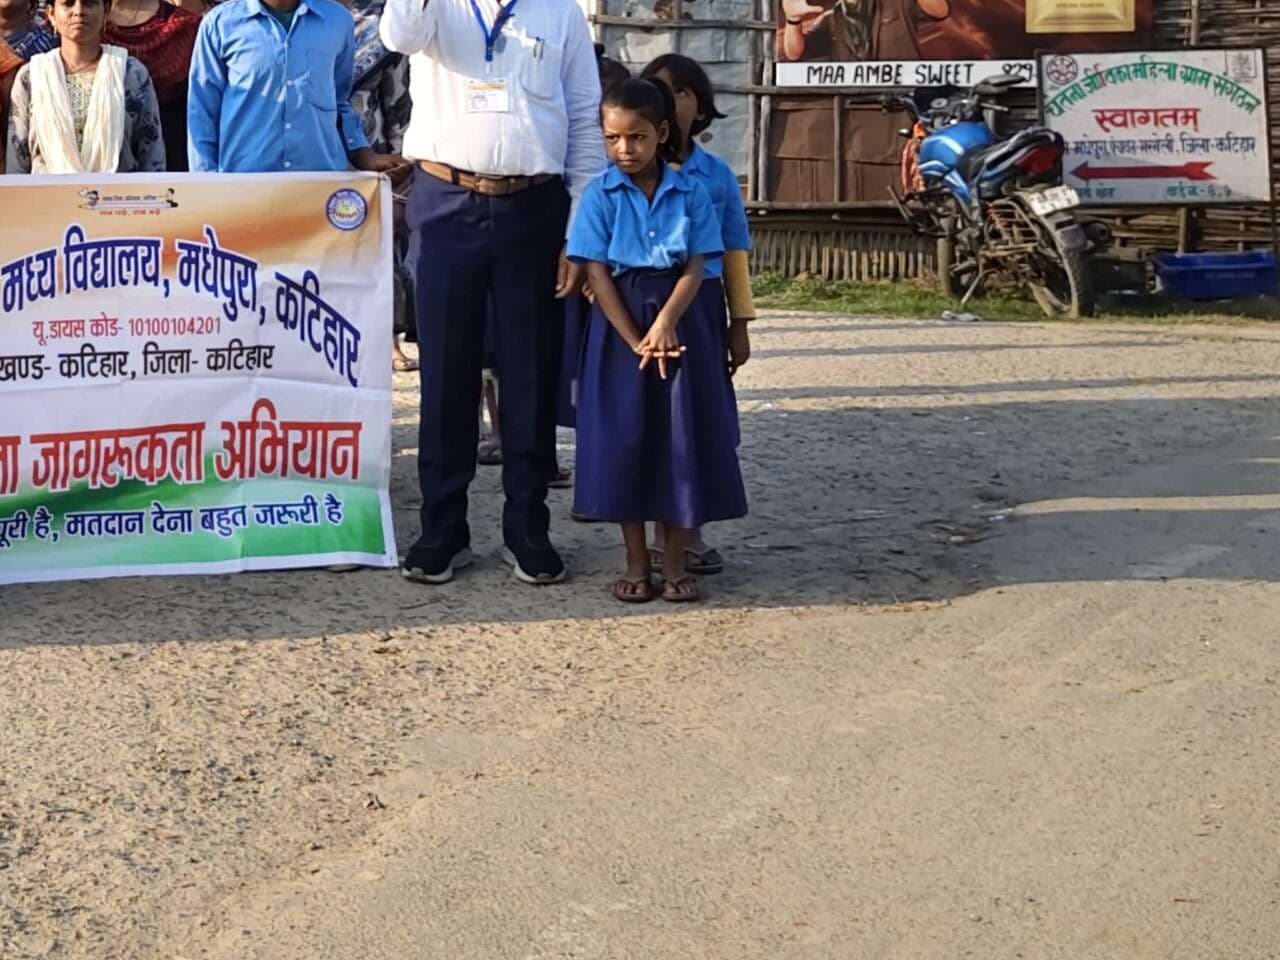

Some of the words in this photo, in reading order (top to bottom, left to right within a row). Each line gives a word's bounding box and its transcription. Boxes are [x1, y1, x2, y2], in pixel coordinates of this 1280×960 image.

[807, 65, 845, 84] MAA
[853, 64, 903, 84] AMBE
[915, 63, 974, 84] SWEET
[1092, 108, 1200, 132] स्वागतम्
[1, 249, 57, 312] मध्य
[64, 226, 170, 298] विद्यालय,
[178, 227, 266, 326] मधेपुरा,
[275, 270, 361, 388] कटिहार
[128, 316, 221, 336] 10100104201
[58, 343, 136, 380] कटिहार,
[143, 341, 198, 375] जिला-
[206, 338, 275, 372] कटिहार
[30, 422, 205, 489] जागरूकता
[215, 398, 362, 480] अभियान
[34, 508, 58, 542] है,
[66, 511, 144, 537] मतदान
[152, 503, 192, 533] देना
[200, 505, 246, 536] बहुत
[253, 495, 317, 525] जरूरी
[324, 494, 341, 523] है
